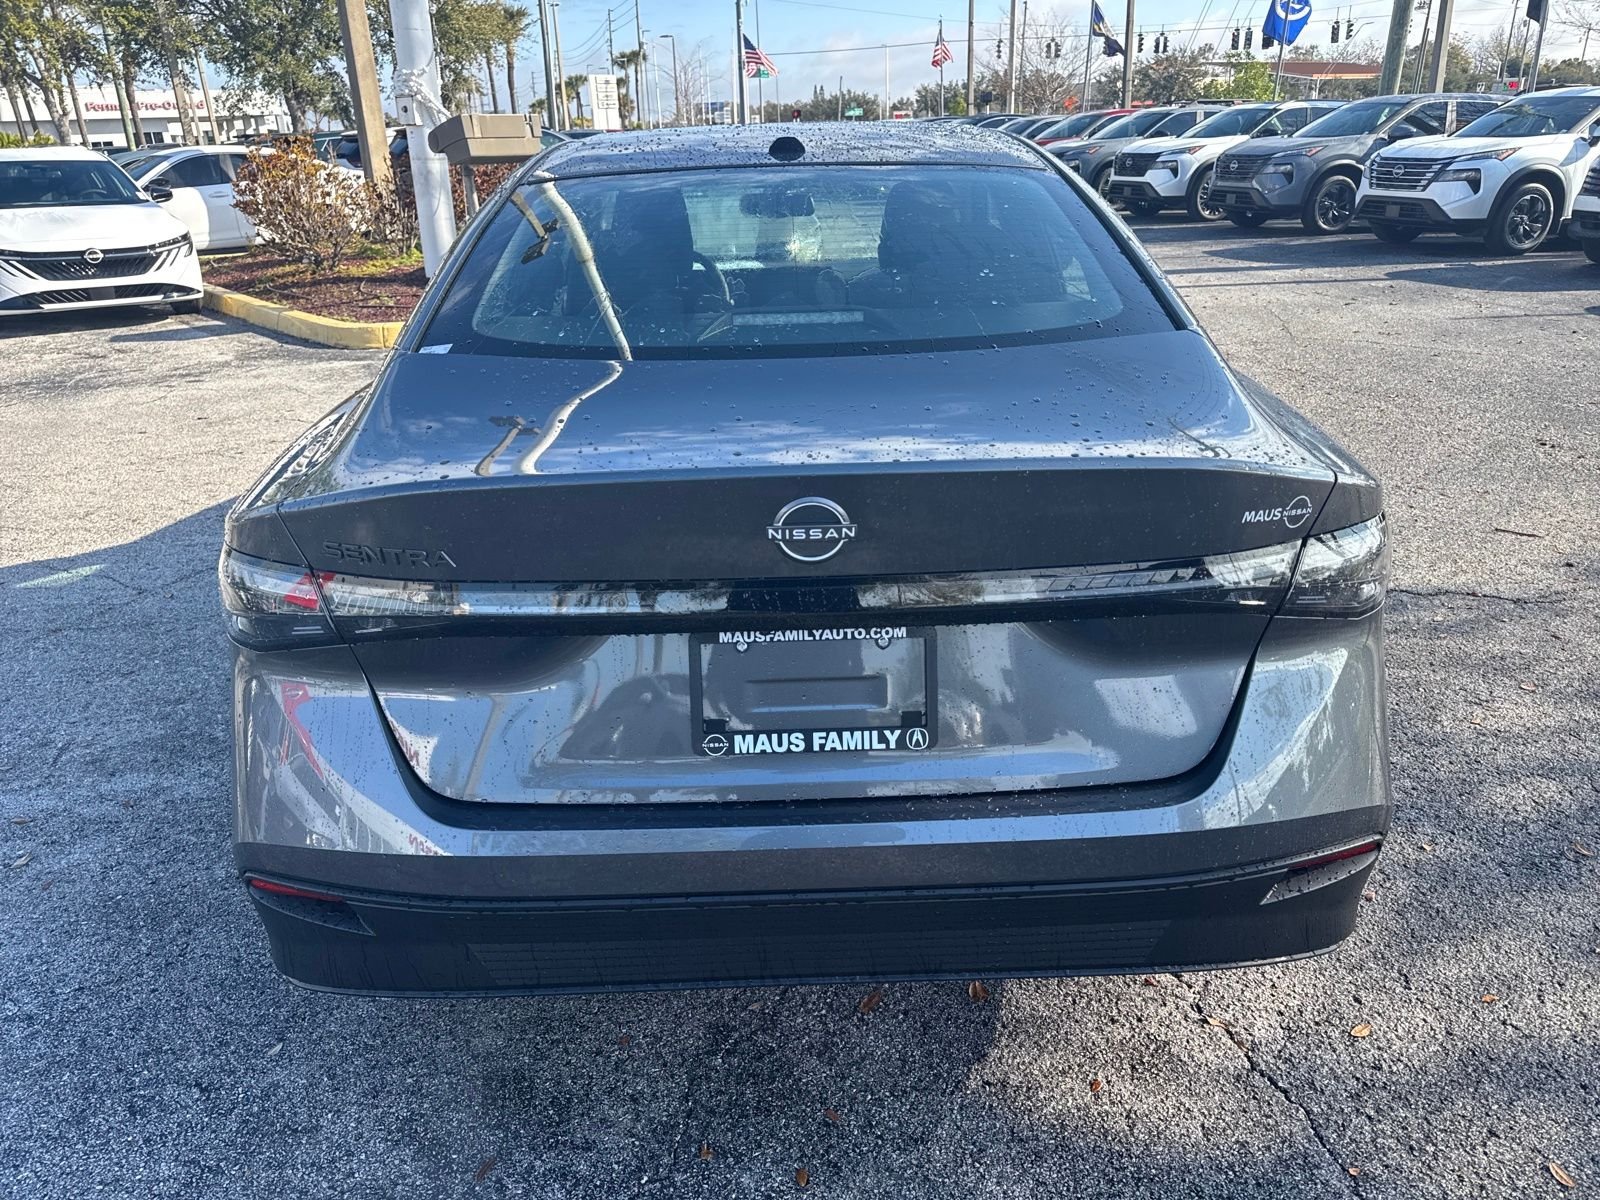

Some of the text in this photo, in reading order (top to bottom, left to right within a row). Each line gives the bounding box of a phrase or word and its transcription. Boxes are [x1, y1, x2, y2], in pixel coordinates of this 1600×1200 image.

[85, 101, 131, 112] Ferm
[1241, 507, 1313, 524] MAUS NISSAN
[767, 526, 856, 540] NISSAN
[322, 540, 457, 568] SENTRA
[718, 627, 907, 643] MAUSFAMILYAUTO.COM
[734, 733, 806, 754] MAUS
[812, 729, 902, 752] FAMILY
